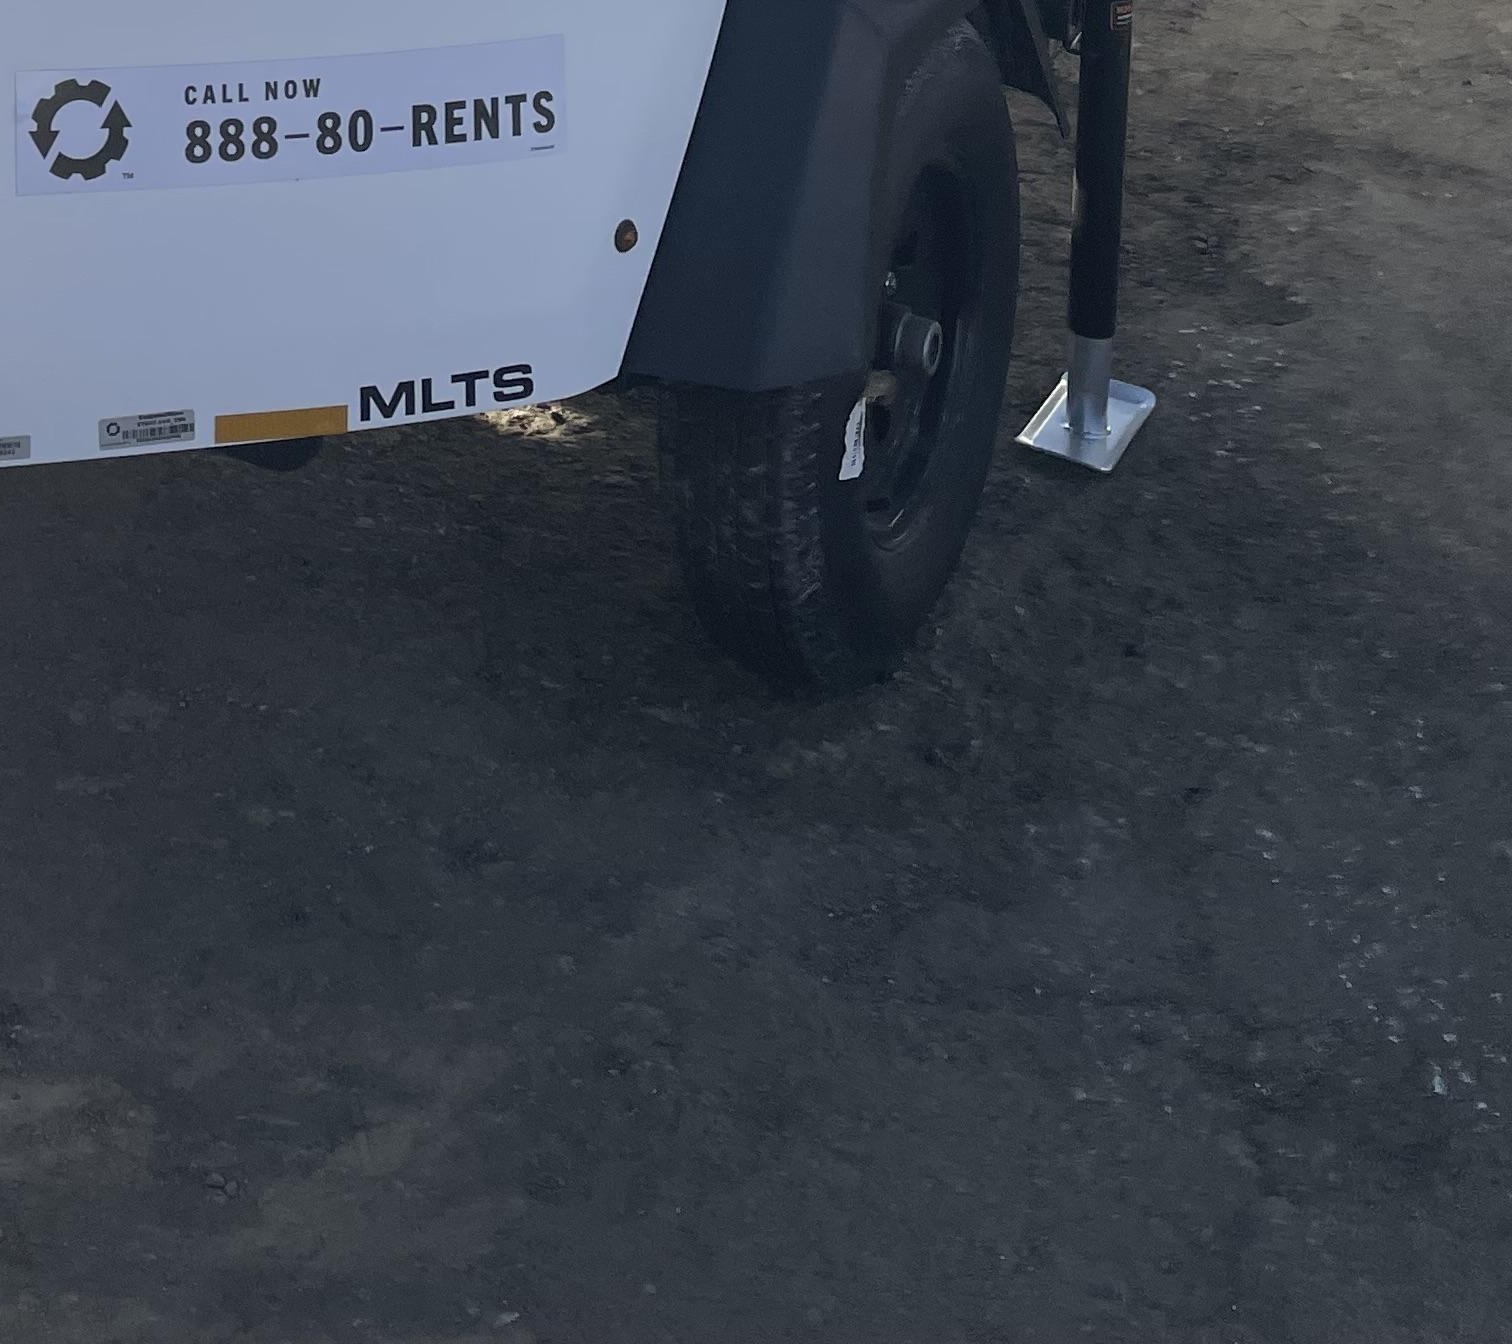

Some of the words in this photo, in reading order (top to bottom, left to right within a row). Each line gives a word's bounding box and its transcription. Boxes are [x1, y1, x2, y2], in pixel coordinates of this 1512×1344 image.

[184, 83, 250, 105] CALL
[264, 78, 322, 101] NOW
[184, 90, 557, 164] 888-80-RENTS
[359, 364, 534, 422] MLTS
